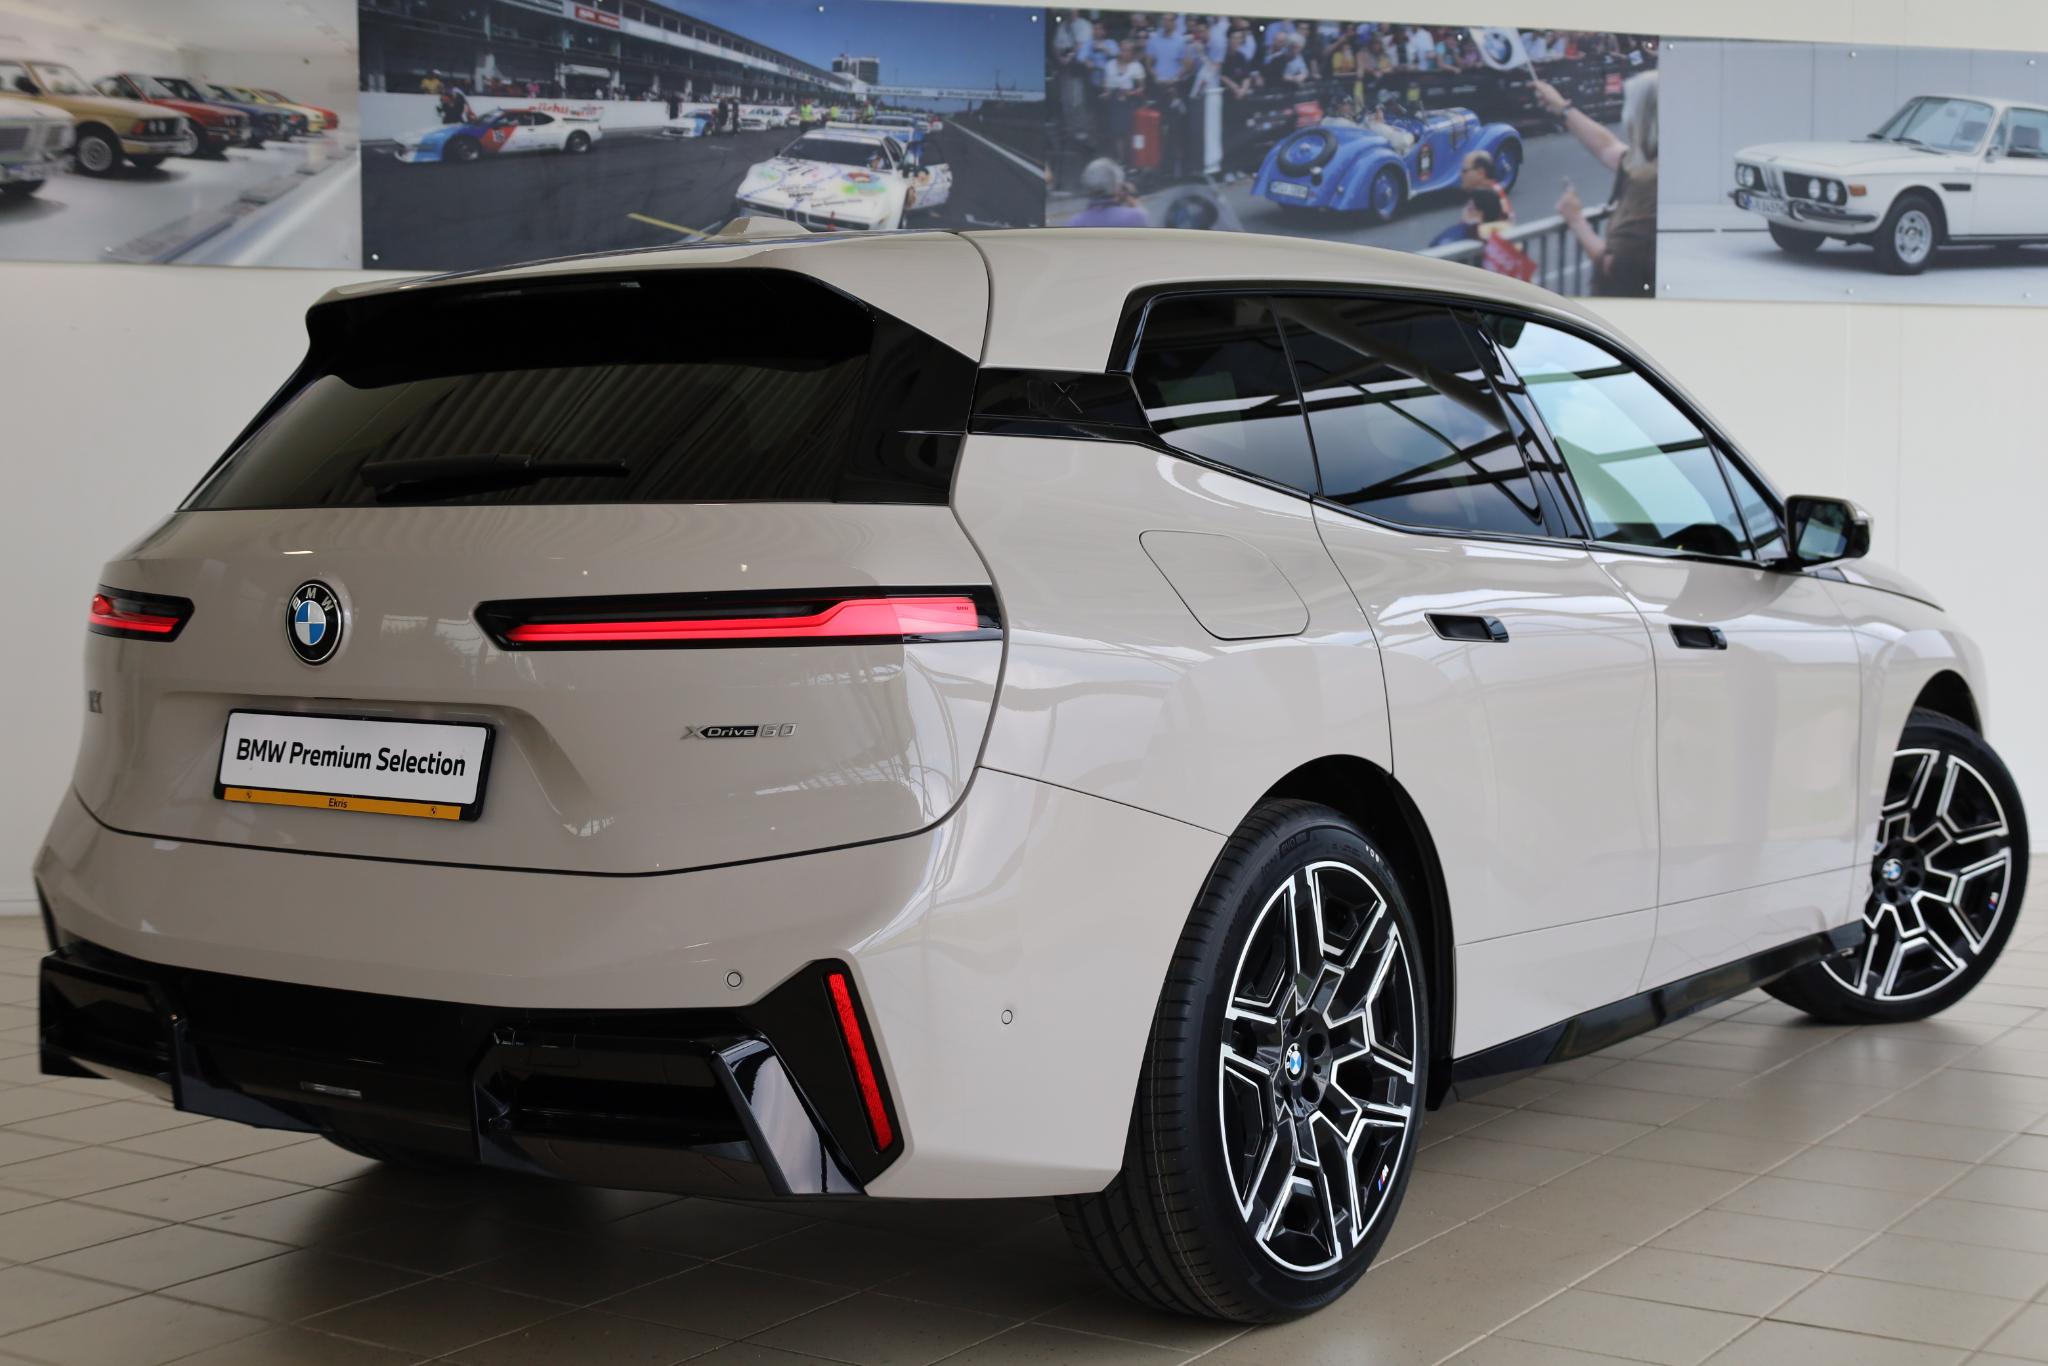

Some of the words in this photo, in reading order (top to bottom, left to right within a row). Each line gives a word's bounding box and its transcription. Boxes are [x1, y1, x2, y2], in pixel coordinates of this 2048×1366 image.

[292, 587, 334, 611] BMW
[236, 738, 287, 764] BMW
[289, 741, 373, 770] Premium
[375, 747, 466, 777] Selection
[328, 797, 348, 809] Ekris
